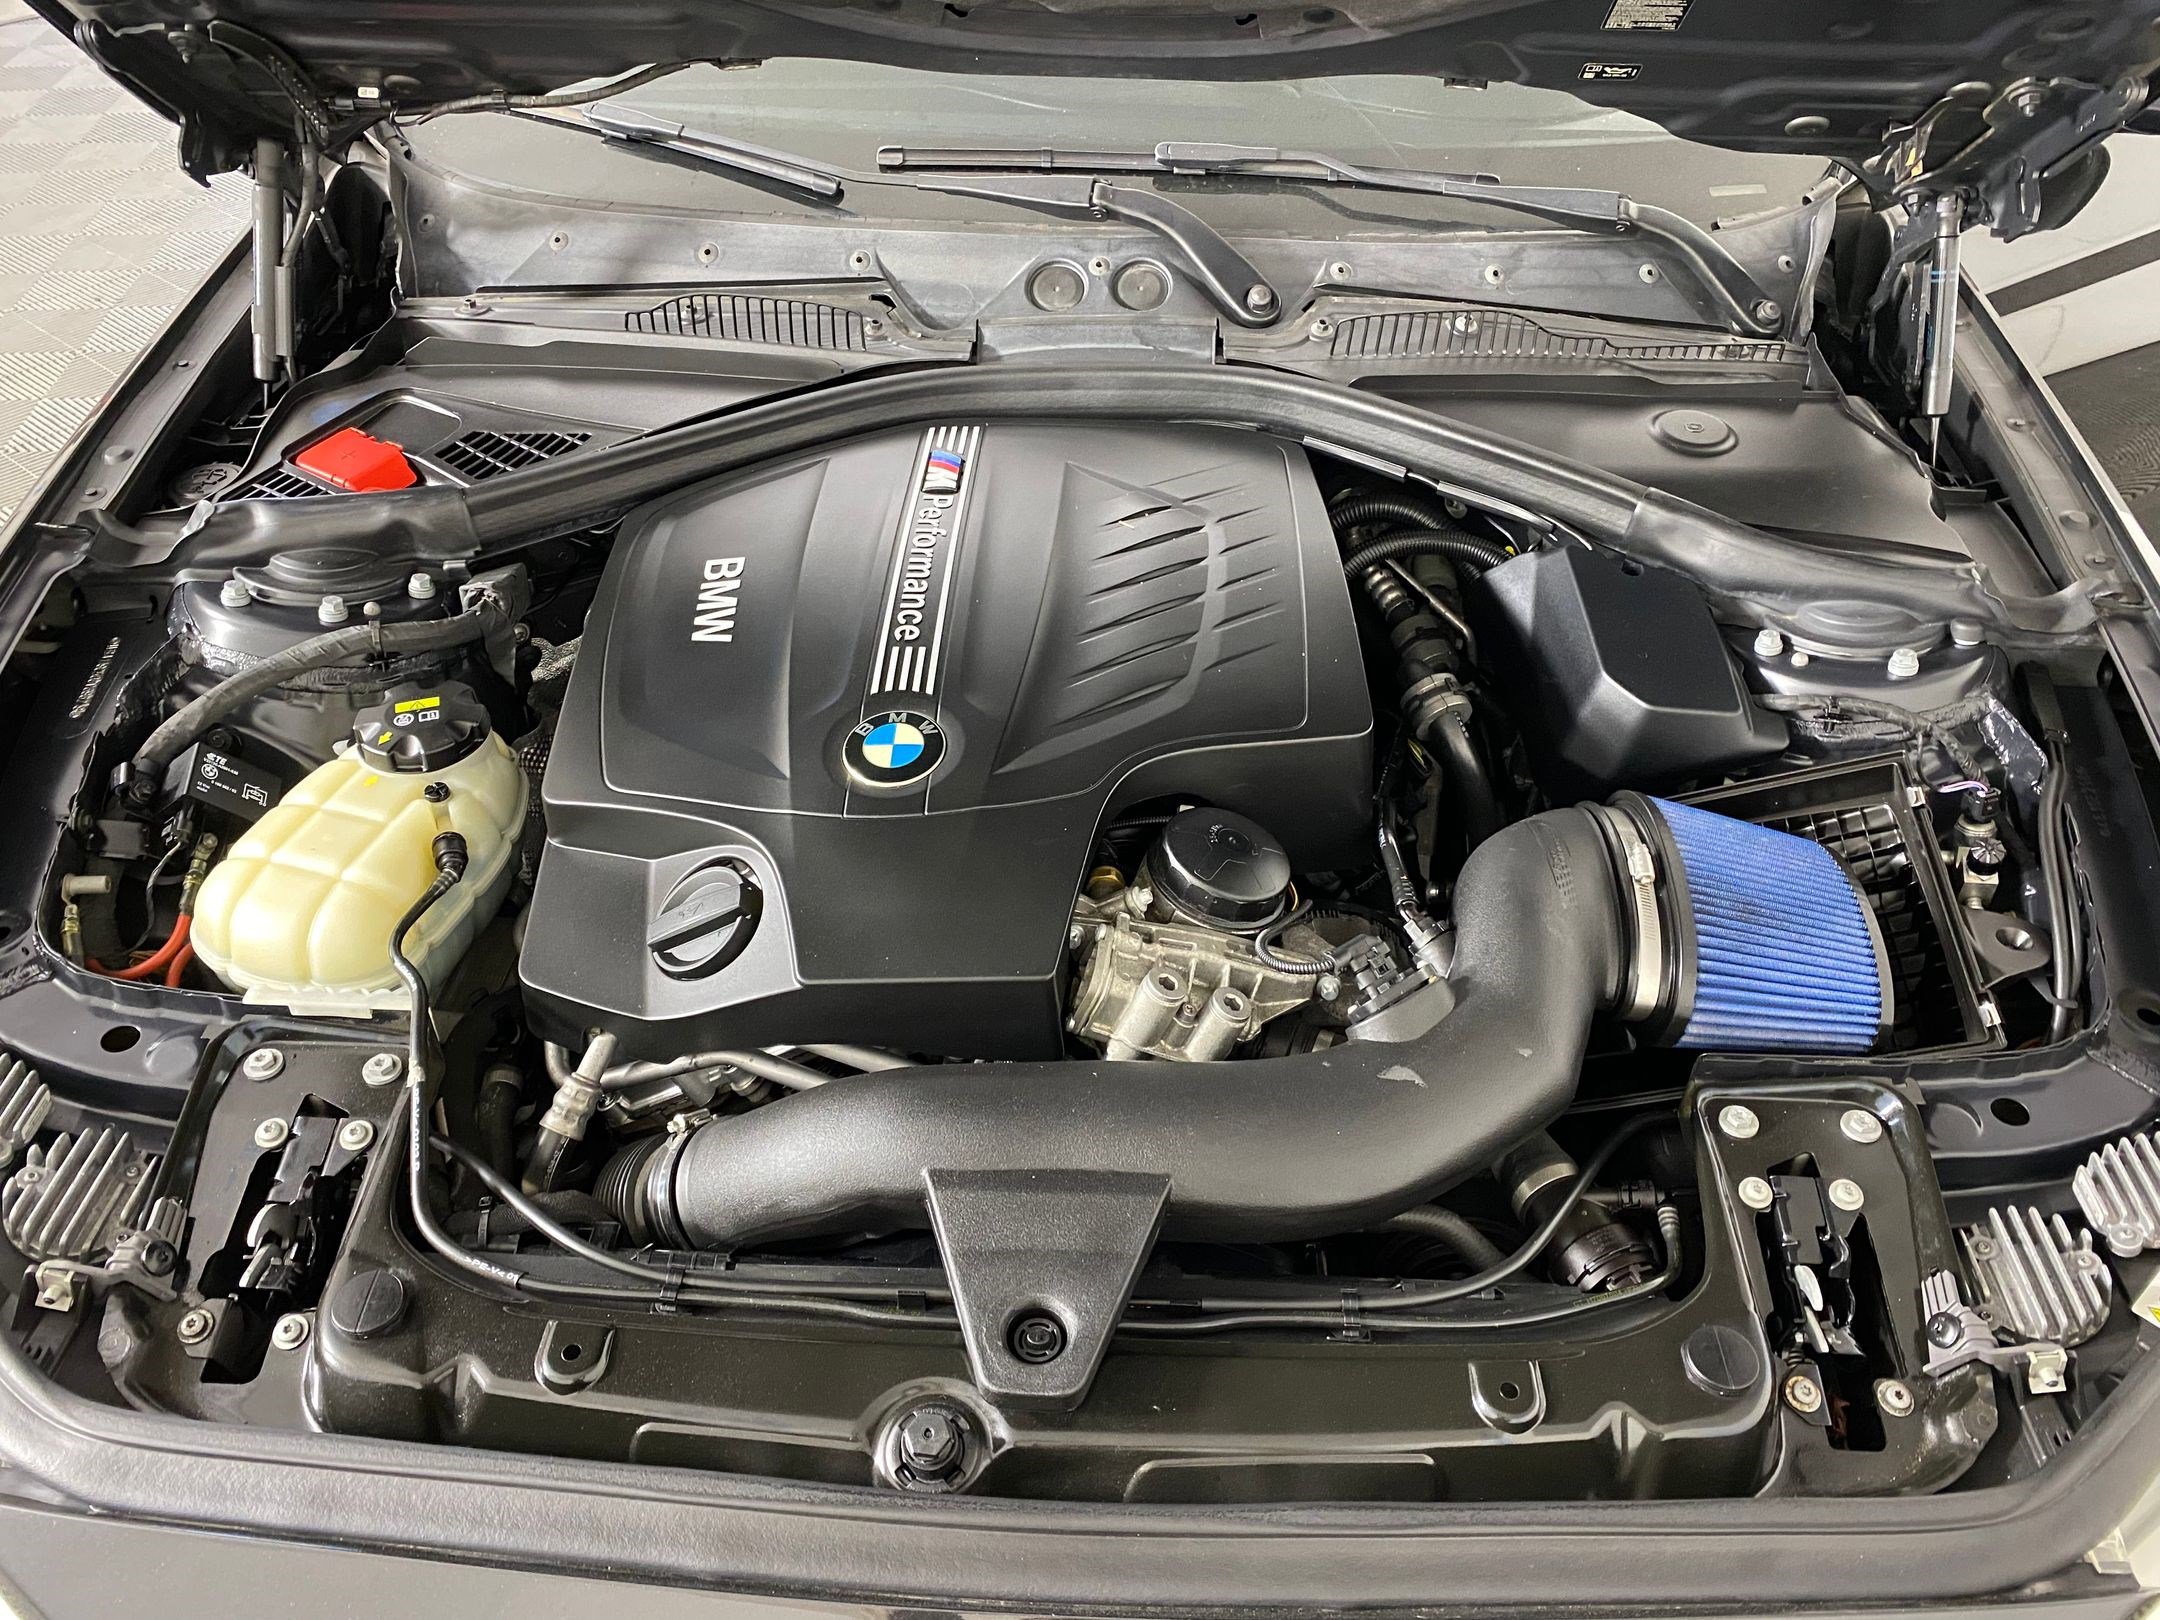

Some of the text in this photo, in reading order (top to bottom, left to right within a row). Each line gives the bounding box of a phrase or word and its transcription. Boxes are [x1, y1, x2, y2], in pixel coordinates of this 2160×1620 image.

[691, 556, 746, 643] BMW
[894, 493, 953, 642] Performance
[855, 712, 939, 737] BMW
